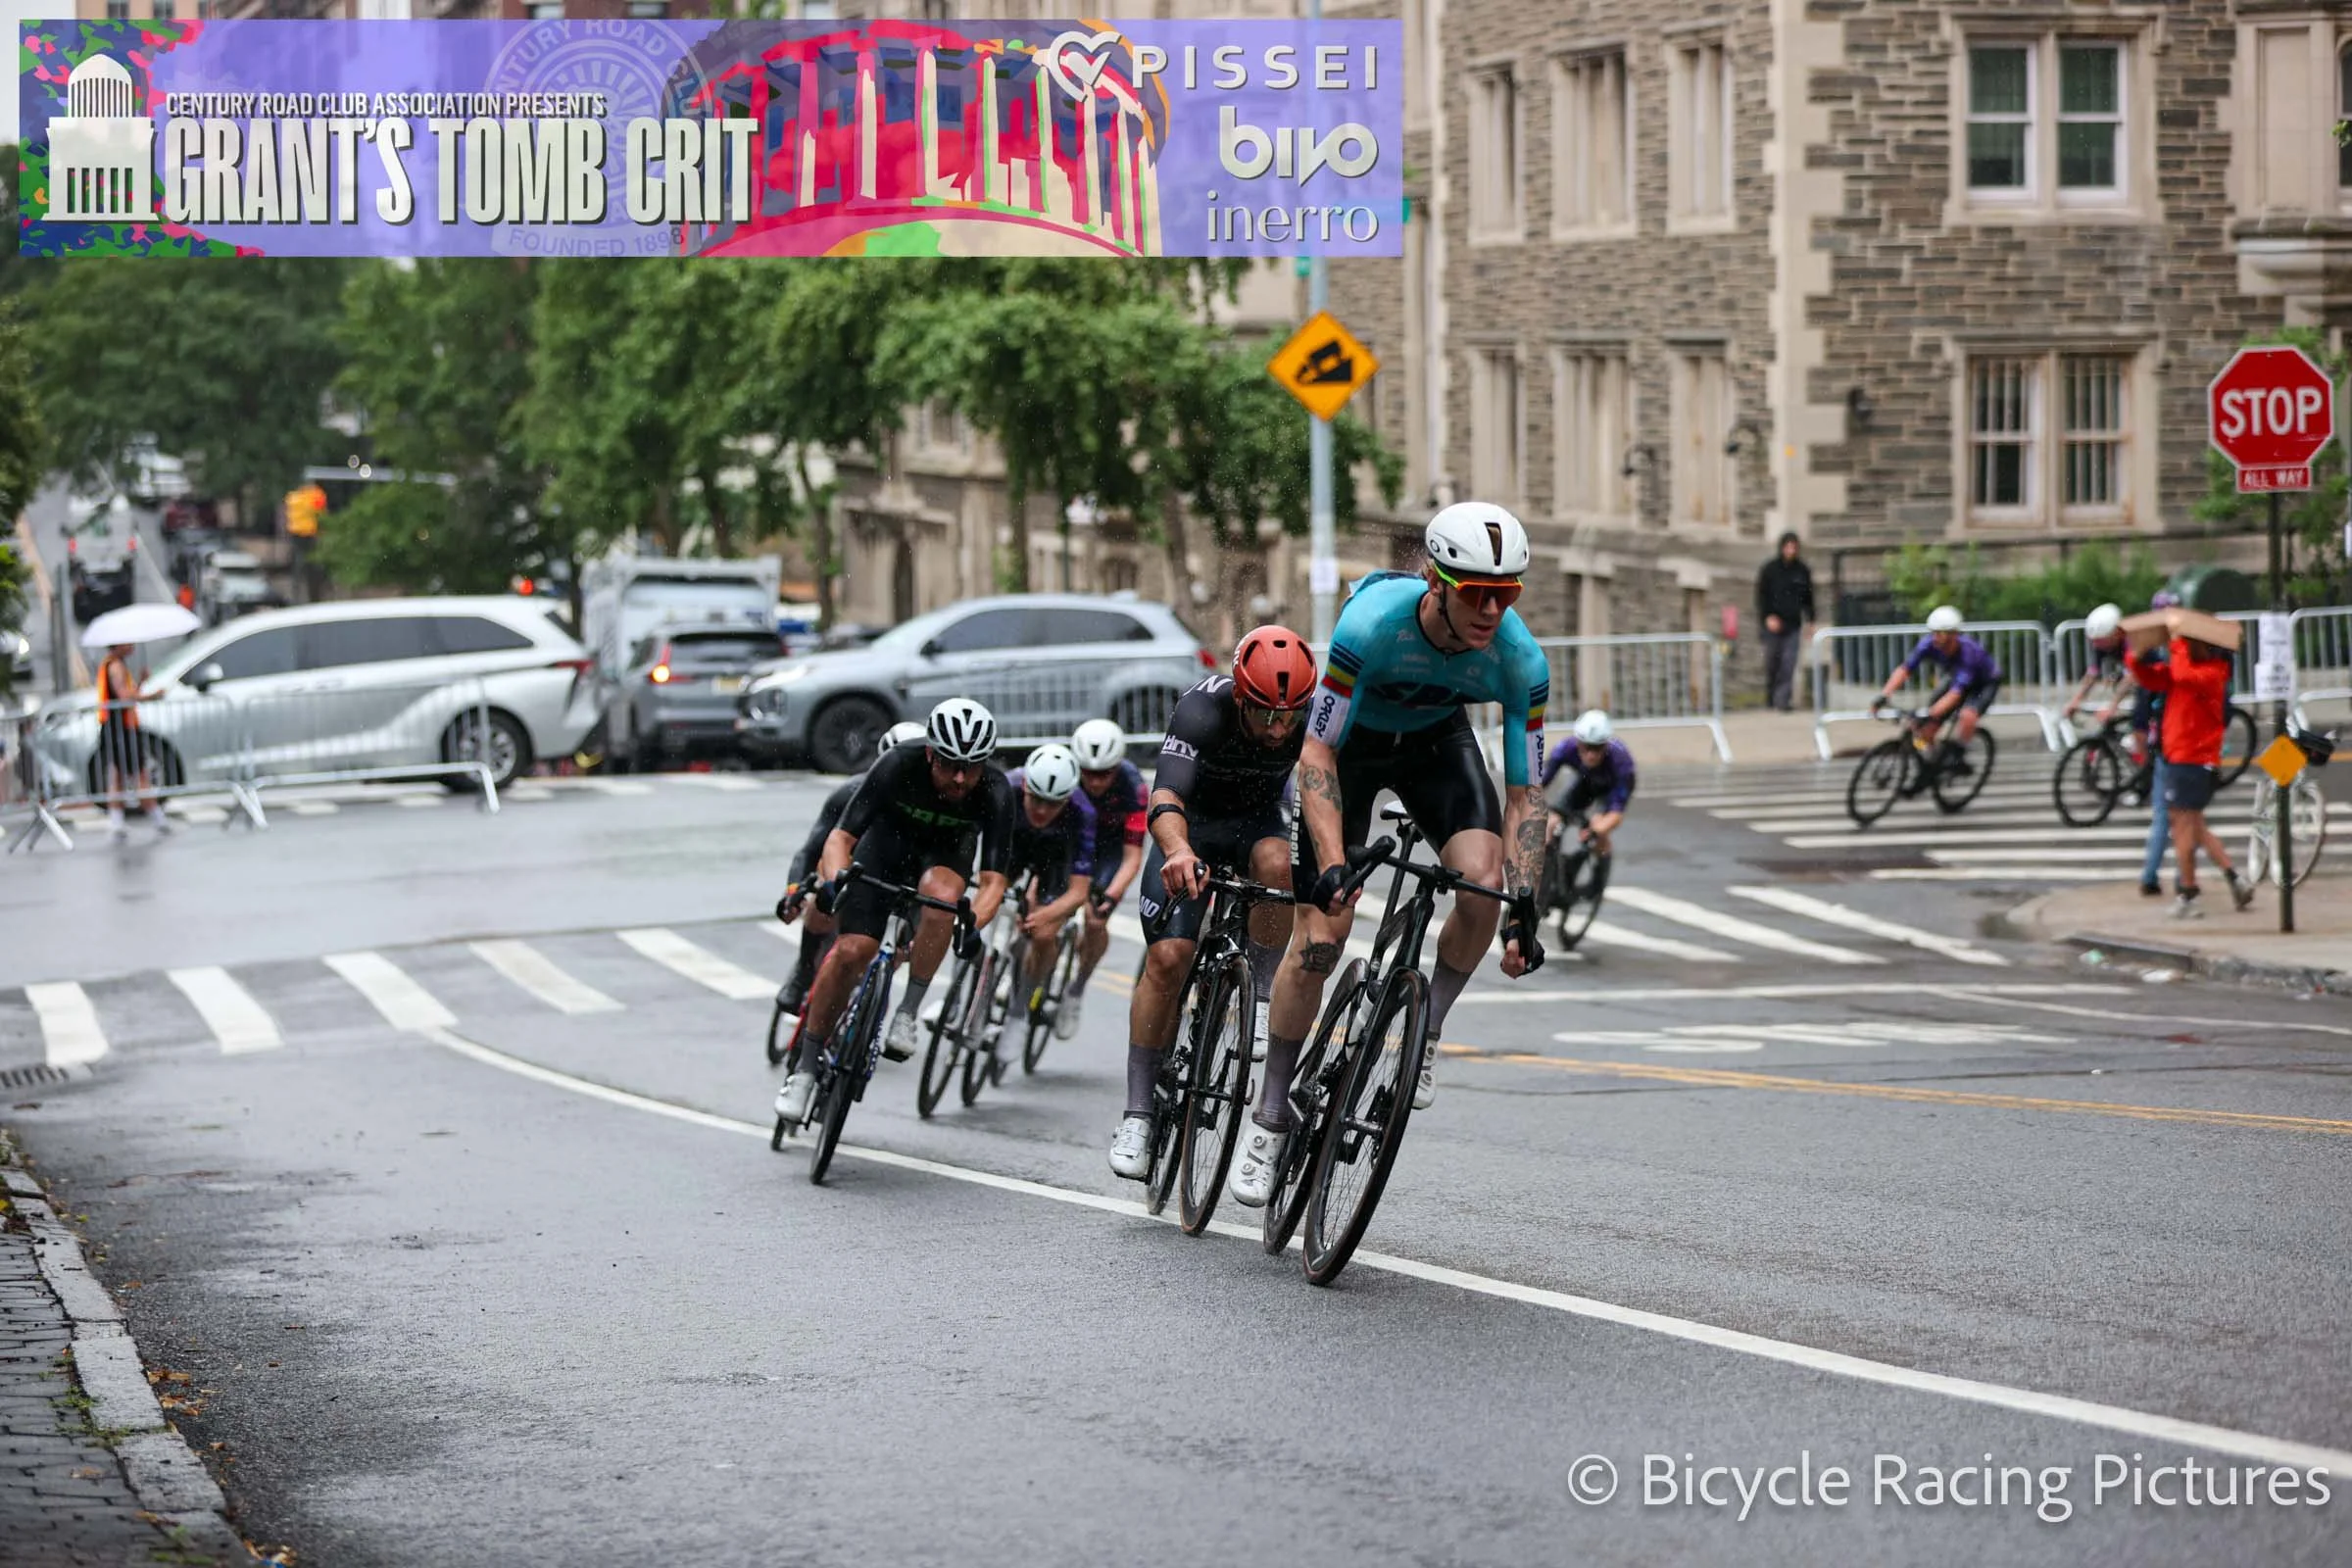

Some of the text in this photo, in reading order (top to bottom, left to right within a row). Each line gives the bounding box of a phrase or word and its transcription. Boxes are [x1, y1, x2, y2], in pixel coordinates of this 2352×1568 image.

[2220, 386, 2323, 438] STOP
[2244, 468, 2304, 487] ALL WAY
